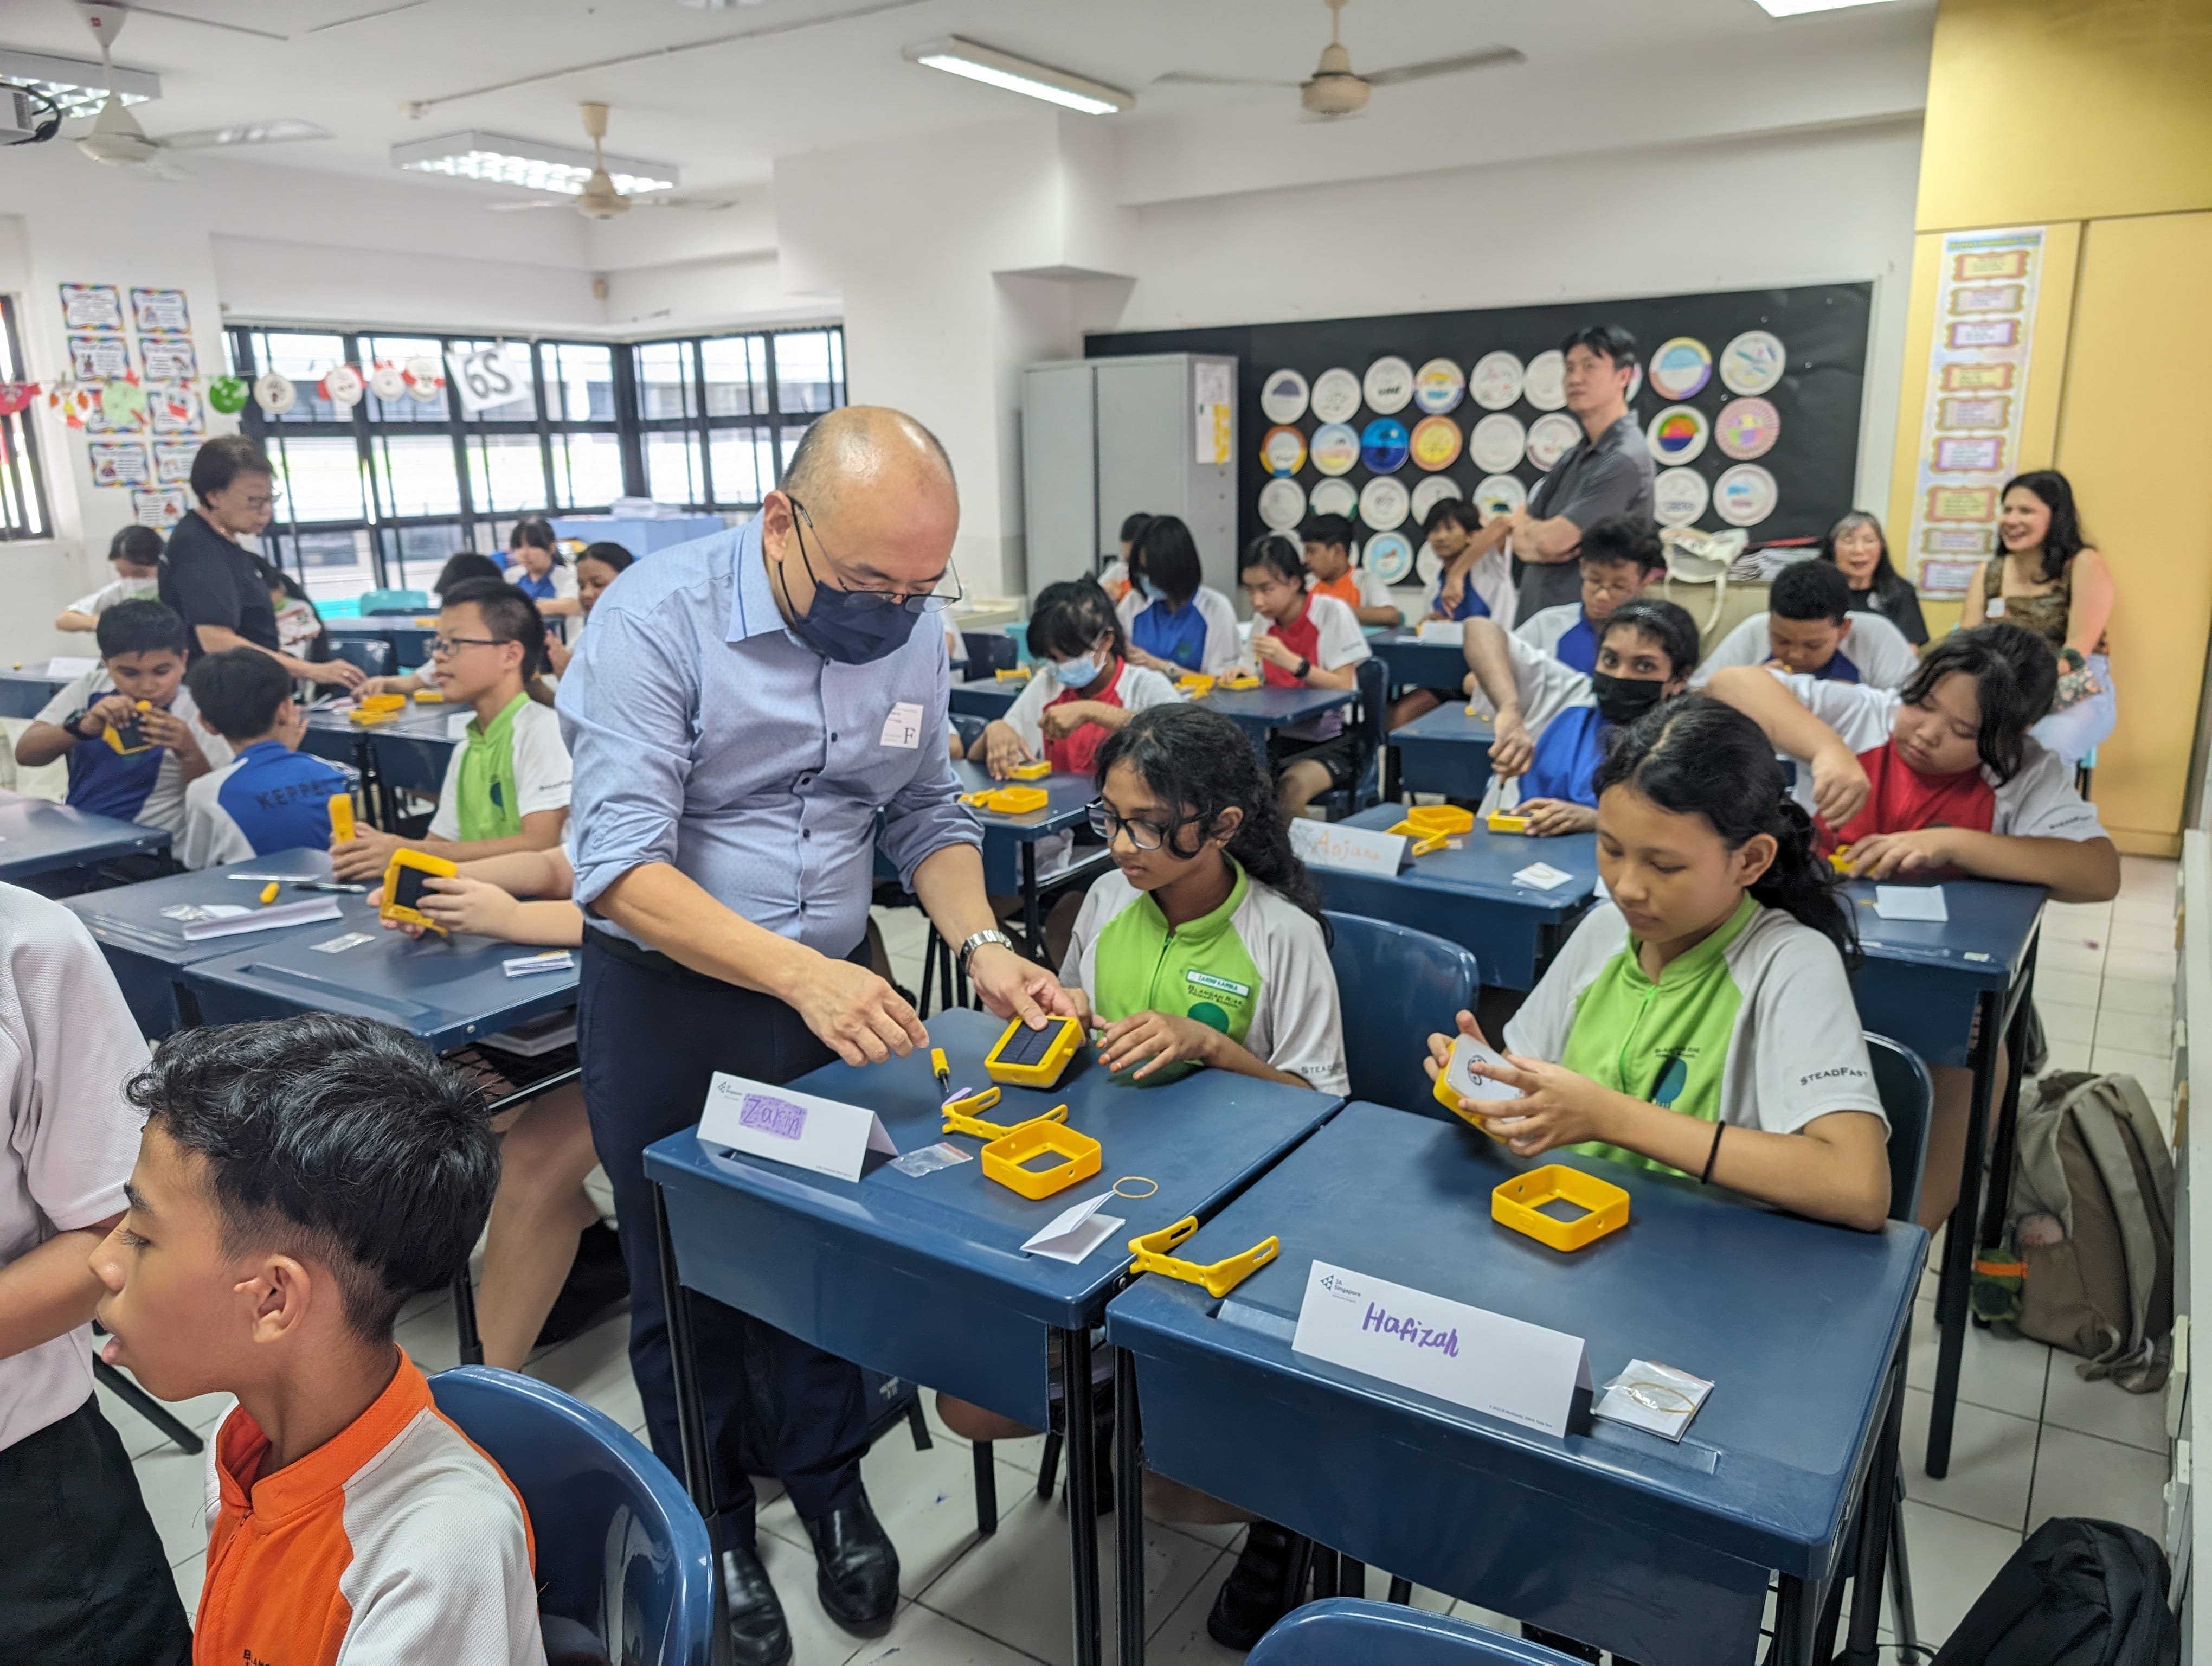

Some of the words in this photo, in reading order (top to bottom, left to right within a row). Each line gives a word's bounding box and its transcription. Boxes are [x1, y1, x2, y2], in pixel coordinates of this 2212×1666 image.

[1800, 1067, 1868, 1086] STEADFAST
[743, 1098, 800, 1136] Zarin
[1334, 1284, 1361, 1297] Singapore
[1362, 1301, 1459, 1357] Hafizah
